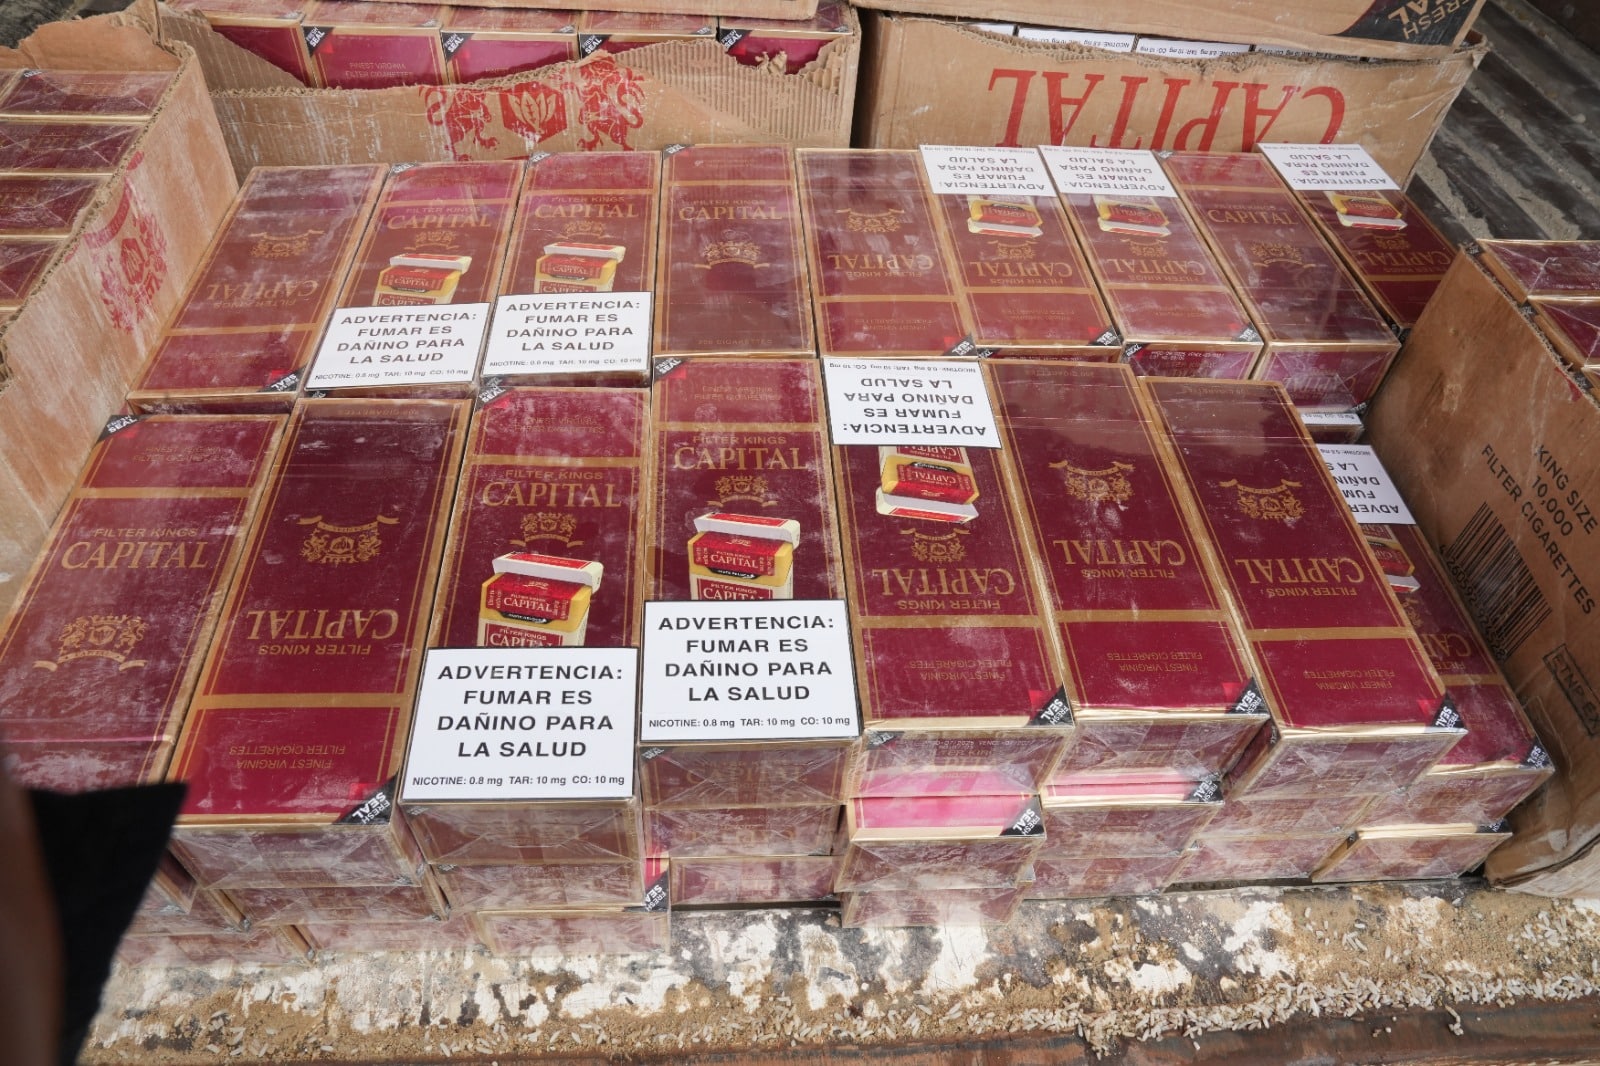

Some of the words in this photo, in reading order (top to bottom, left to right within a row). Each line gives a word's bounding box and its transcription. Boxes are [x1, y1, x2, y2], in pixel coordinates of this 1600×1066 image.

[309, 30, 325, 47] SEAL
[448, 36, 464, 53] SEAL
[724, 31, 742, 49] SEAL
[584, 38, 602, 54] SEAL
[989, 68, 1345, 153] CAPITAL
[937, 164, 976, 172] PARA
[1059, 164, 1096, 172] PARA
[1068, 157, 1115, 165] SALUD
[980, 165, 1034, 173] DAÑINO
[1100, 166, 1153, 174] DAÑINO
[1097, 174, 1146, 182] FUMAR
[535, 203, 640, 219] CAPITAL
[679, 206, 783, 220] CAPITAL
[1207, 209, 1299, 225] CAPITAL
[386, 214, 492, 231] CAPITAL
[827, 254, 934, 270] CAPITAL
[1358, 251, 1451, 266] CAPITAL
[969, 261, 1073, 277] CAPITAL
[1106, 259, 1206, 276] CAPITAL
[206, 280, 319, 301] CAPITAL
[505, 300, 641, 312] ADVERTENCIA:
[341, 312, 477, 325] ADVERTENCIA:
[524, 314, 588, 324] FUMAR
[594, 314, 618, 322] ES
[357, 326, 422, 337] FUMAR
[429, 325, 453, 335] ES
[505, 325, 578, 338] DAÑINO
[583, 326, 635, 337] PARA
[336, 338, 411, 352] DAÑINO
[415, 338, 465, 349] PARA
[520, 342, 545, 352] LA
[551, 341, 615, 351] SALUD
[348, 355, 373, 364] LA
[379, 352, 444, 363] SALUD
[860, 378, 923, 388] SALUD
[928, 379, 953, 389] LA
[844, 393, 895, 402] PARA
[902, 393, 973, 406] DAÑINO
[863, 408, 888, 418] ES
[894, 408, 961, 419] FUMAR
[843, 423, 986, 436] ADVERTENCIA:
[692, 436, 739, 445] FILTER
[743, 436, 786, 445] KINGS
[672, 447, 808, 471] CAPITAL
[504, 469, 557, 479] FILTER
[560, 470, 603, 480] KINGS
[1337, 463, 1358, 472] LA
[1333, 476, 1381, 486] DAÑIN
[482, 481, 622, 508] CAPITAL
[1342, 489, 1376, 499] FUM
[1537, 444, 1569, 490] KING
[1566, 490, 1598, 535] SIZE
[1532, 475, 1574, 537] 10,000
[94, 528, 145, 537] FILTER
[150, 528, 199, 537] KINGS
[1481, 443, 1522, 502] FILTER
[1521, 501, 1596, 615] CIGARETTES
[61, 541, 209, 569] CAPITAL
[1053, 540, 1187, 566] CAPITAL
[710, 554, 759, 569] CAPITAL
[1080, 568, 1124, 578] KINGS
[1129, 568, 1176, 578] FILTER
[1234, 557, 1365, 584] CAPITAL
[872, 568, 1015, 596] CAPITAL
[1265, 587, 1308, 596] KINGS
[1311, 586, 1358, 596] FILTER
[503, 597, 553, 613] CAPITAL
[898, 600, 945, 609] KINGS
[949, 600, 1001, 609] FILTER
[246, 609, 399, 639] CAPITAL
[658, 616, 834, 631] ADVERTENCIA:
[258, 644, 310, 655] KINGS
[314, 644, 372, 655] FILTER
[686, 639, 770, 653] FUMAR
[778, 638, 809, 652] ES
[437, 664, 623, 680] ADVERTENCIA:
[664, 660, 759, 677] DAÑINO
[767, 662, 833, 676] PARA
[1119, 663, 1163, 672] VIRGINIA
[1165, 663, 1198, 672] FINEST
[463, 690, 552, 705] FUMAR
[560, 690, 592, 705] ES
[688, 687, 720, 701] LA
[727, 686, 810, 701] SALUD
[1235, 690, 1256, 712] SEAL
[1040, 698, 1063, 721] SEAL
[1049, 705, 1070, 725] FRESH
[1435, 705, 1452, 727] SEAL
[437, 712, 536, 731] DAÑINO
[545, 715, 614, 731] PARA
[649, 719, 700, 728] NICOTINE:
[702, 719, 718, 727] 0.8
[719, 720, 735, 729] mg
[740, 718, 764, 727] TAR:
[766, 718, 778, 727] 10
[779, 719, 796, 728] mg
[800, 717, 819, 726] CO:
[821, 717, 833, 725] 10
[834, 718, 850, 726] mg
[228, 745, 304, 755] CIGARETTES
[305, 745, 346, 755] FILTER
[458, 741, 490, 758] LA
[499, 741, 587, 757] SALUD
[236, 759, 287, 769] VIRGINIA
[290, 759, 332, 769] FINEST
[412, 776, 467, 786] NICOTINE:
[469, 776, 485, 785] 0.8
[487, 778, 503, 787] mg
[509, 776, 533, 785] TAR:
[537, 776, 548, 785] 10
[550, 777, 566, 786] mg
[572, 776, 591, 785] CO:
[595, 776, 606, 785] 10
[608, 777, 625, 786] mg
[352, 792, 387, 819] SEAL
[361, 799, 391, 824] FRESH
[1012, 808, 1035, 831] SEAL
[1022, 815, 1040, 836] FRESH
[645, 884, 663, 903] SEA
[645, 891, 667, 912] FRESH
